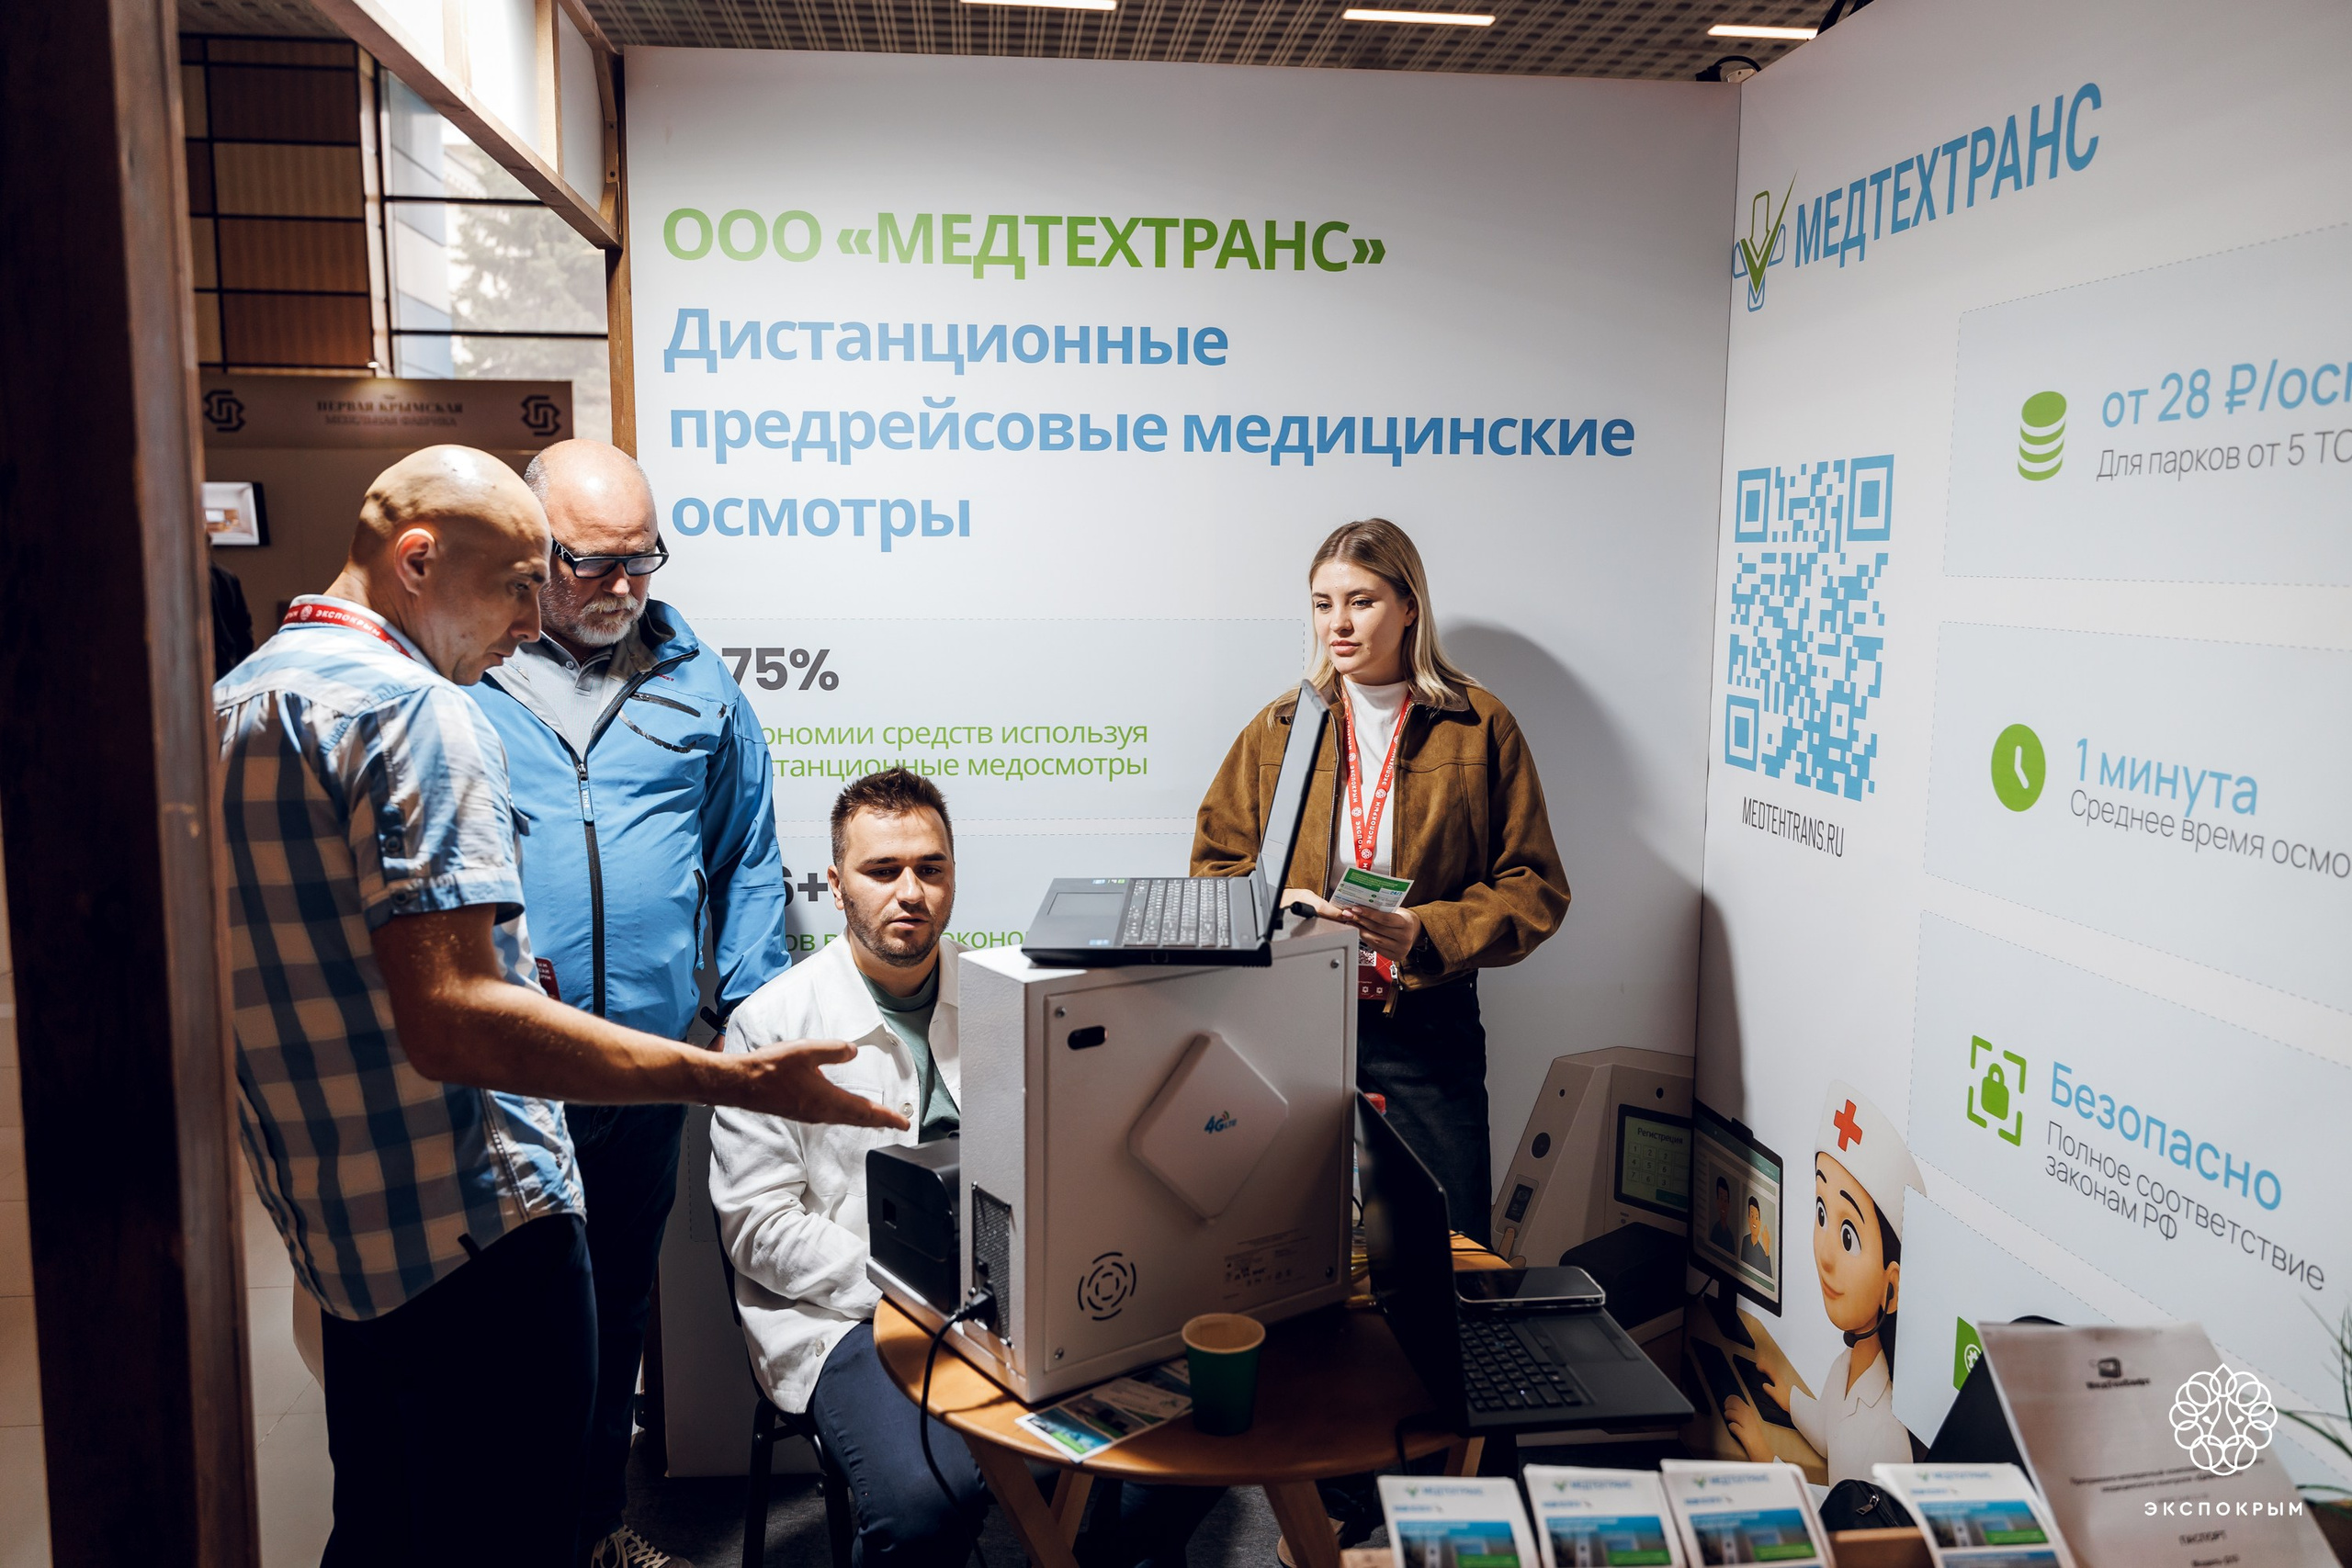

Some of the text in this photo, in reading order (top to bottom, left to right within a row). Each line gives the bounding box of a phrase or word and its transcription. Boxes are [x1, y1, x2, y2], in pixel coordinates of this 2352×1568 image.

[1794, 83, 2102, 268] МЕДТЕХТРАНС
[663, 208, 1385, 279] ООО «МЕДТЕХТРАНС»
[663, 308, 1228, 376] Дистанционные
[2101, 389, 2149, 428] от
[2157, 368, 2211, 422] 28
[670, 396, 1635, 468] предрейсовые медицинские
[2096, 449, 2143, 482] Для
[2148, 446, 2240, 482] парков
[2247, 442, 2281, 468] от
[2288, 433, 2305, 466] 5
[672, 495, 970, 553] осмотры
[315, 609, 381, 637] ЭКСПОКРЫМ
[721, 648, 840, 691] 75%
[762, 723, 1148, 751] ономии средств используя
[772, 755, 1148, 782] танционные медосмотры
[2076, 738, 2258, 818] 1 минута
[1365, 802, 1381, 844] ЭКСПОКРЫМ
[1742, 796, 1844, 858] MEDTEHTRANS.RU
[2070, 789, 2176, 838] Среднее
[2181, 818, 2265, 859] время
[2051, 1061, 2282, 1212] Безопасно
[2045, 1155, 2177, 1241] законам РФ
[2047, 1120, 2324, 1291] Полное соответствие
